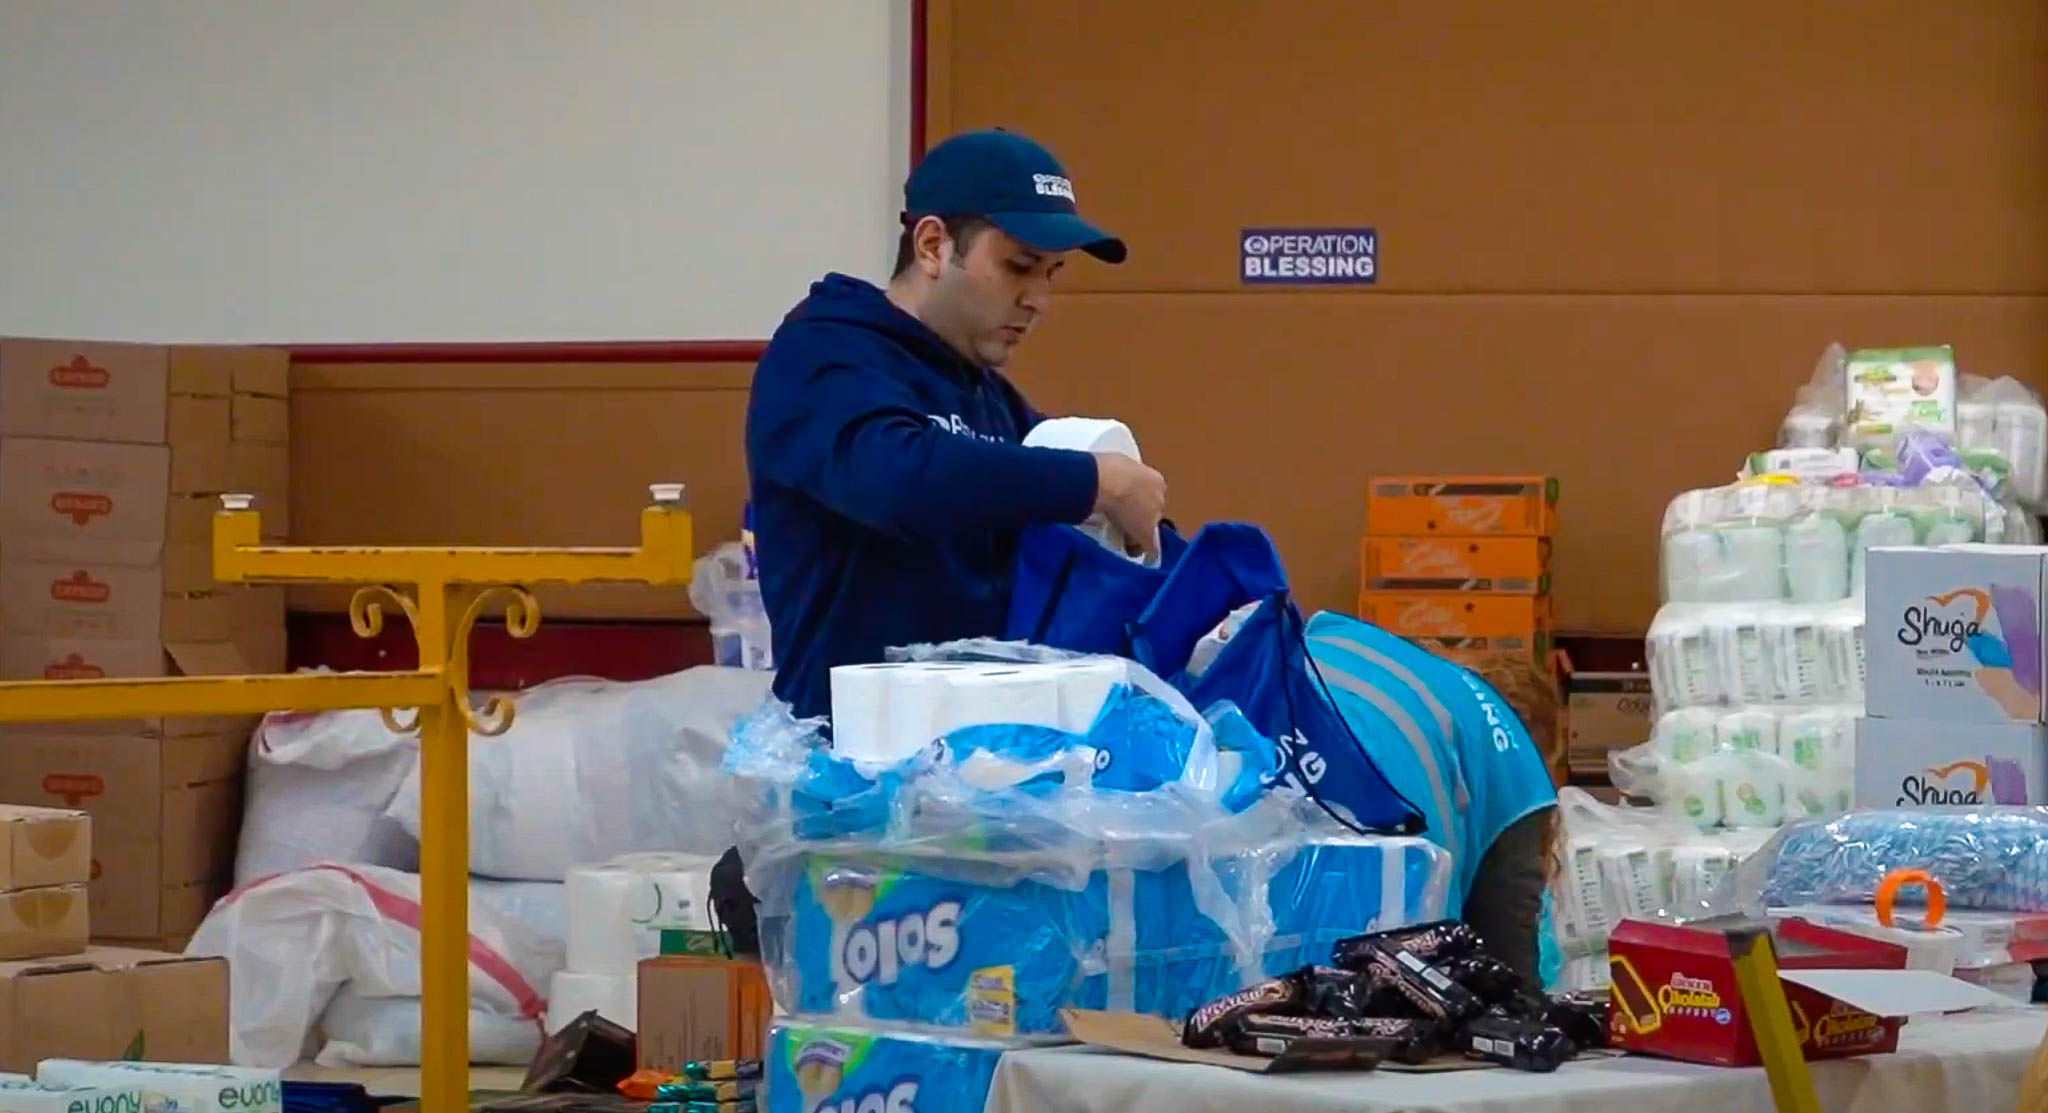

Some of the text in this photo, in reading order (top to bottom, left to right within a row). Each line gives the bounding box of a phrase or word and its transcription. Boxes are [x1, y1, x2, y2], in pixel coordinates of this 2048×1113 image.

[1244, 234, 1374, 254] OPERATION
[1245, 256, 1374, 276] BLESSING
[1897, 606, 1982, 653] Shuga
